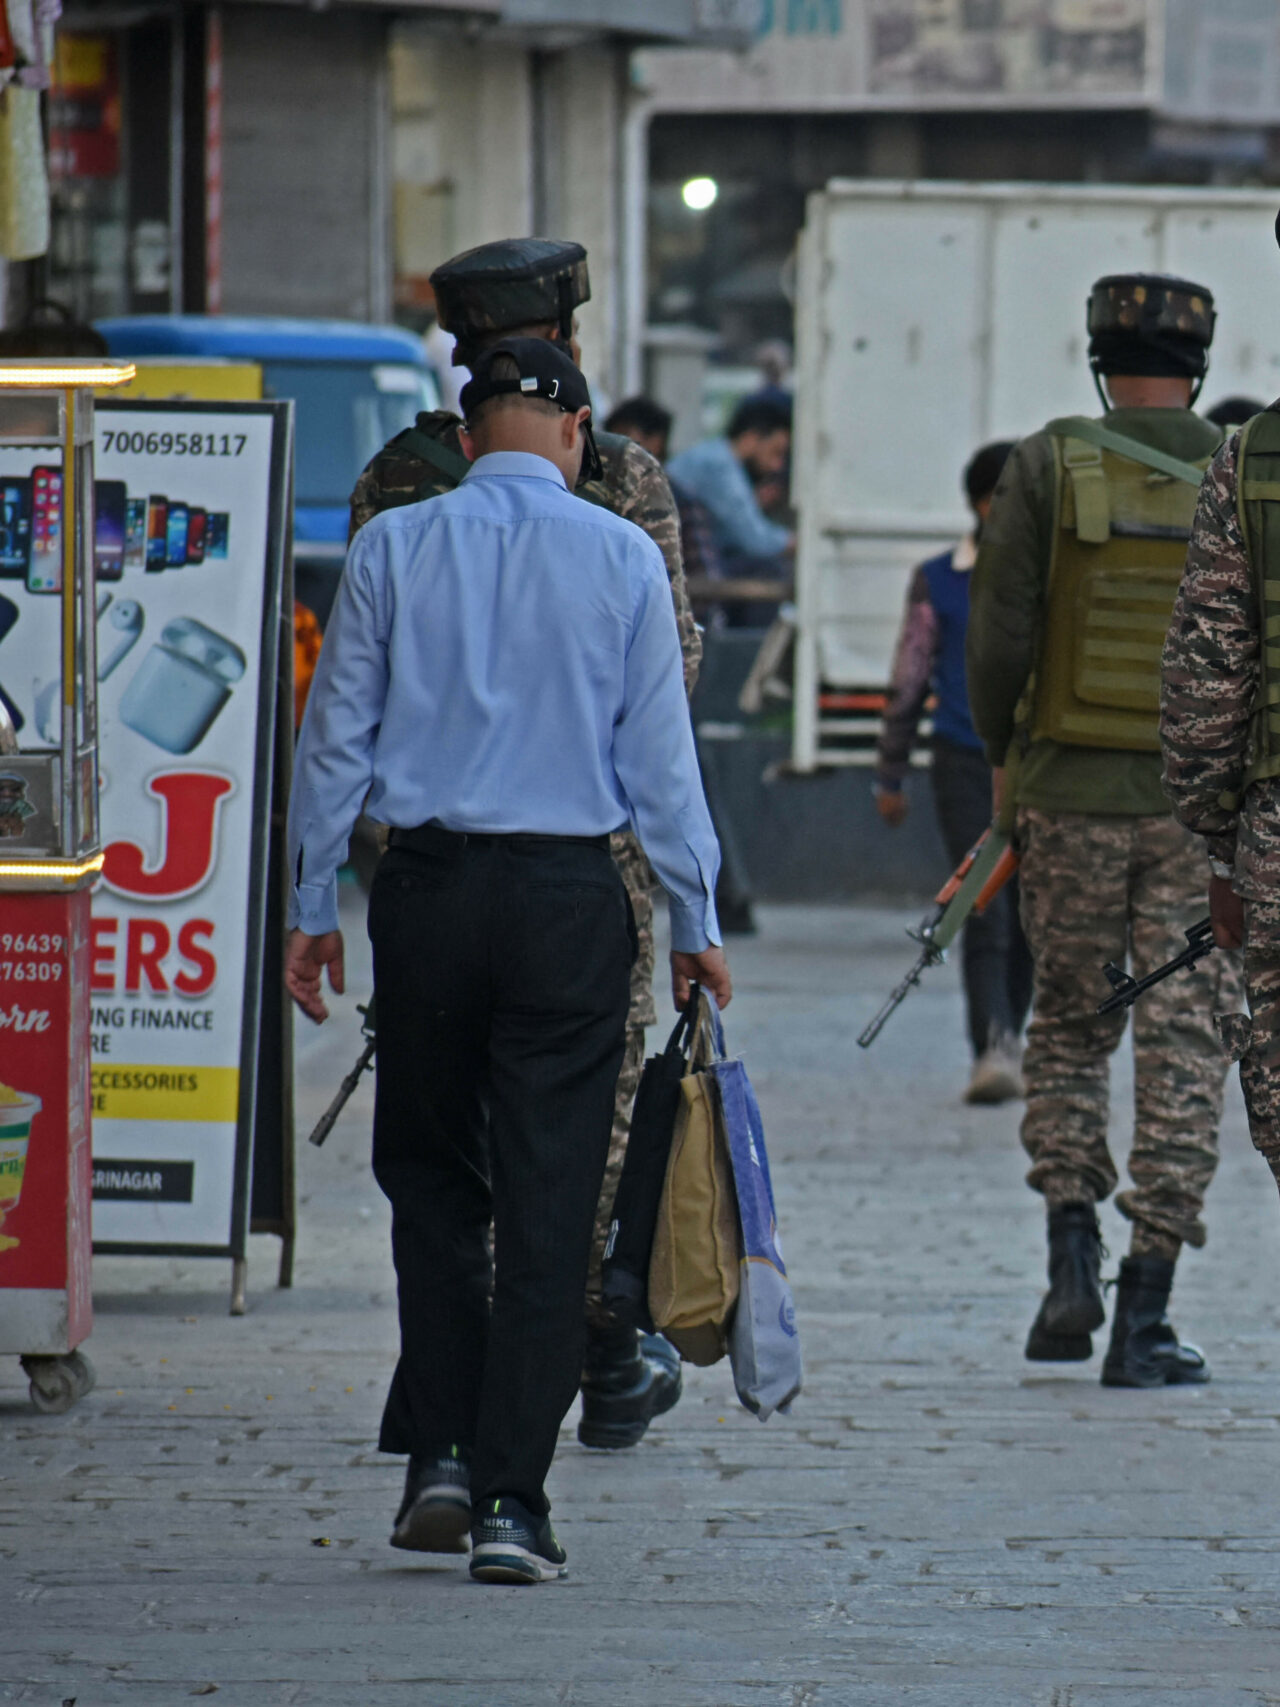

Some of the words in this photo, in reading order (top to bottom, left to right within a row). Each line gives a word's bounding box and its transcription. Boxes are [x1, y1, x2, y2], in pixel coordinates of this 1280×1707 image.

[102, 431, 247, 457] 7006958117
[92, 773, 231, 896] J
[91, 918, 216, 994] ERS
[0, 962, 62, 981] 76309
[131, 1008, 213, 1031] FINANCE
[483, 1518, 513, 1529] NIKE
